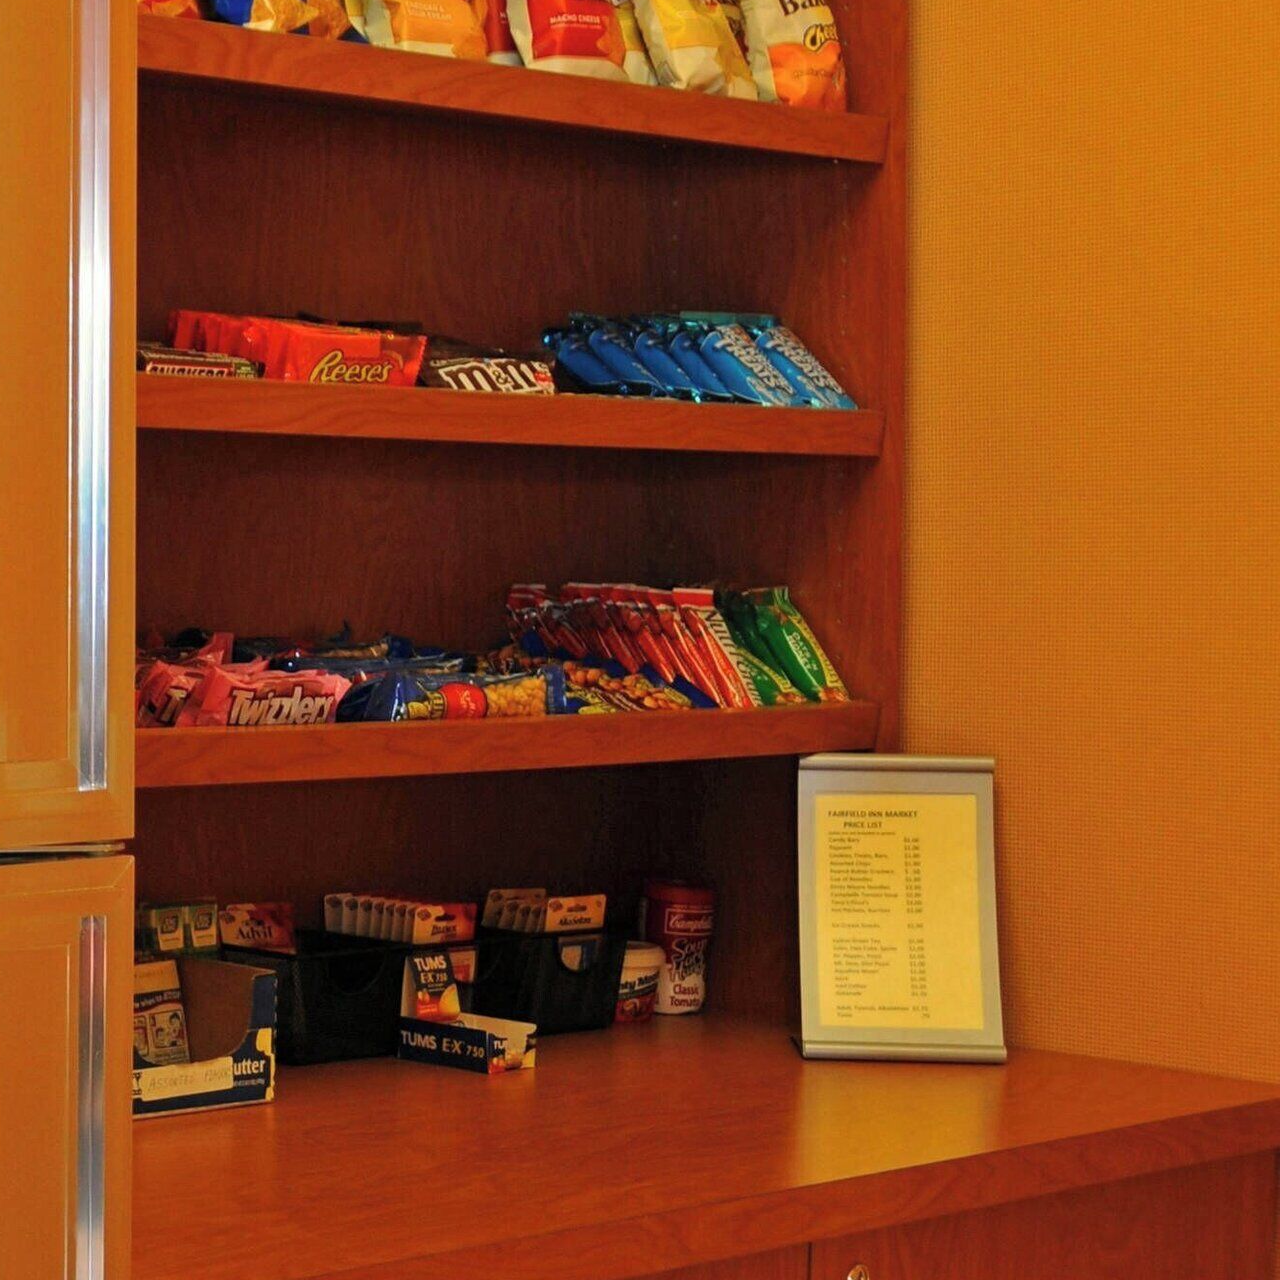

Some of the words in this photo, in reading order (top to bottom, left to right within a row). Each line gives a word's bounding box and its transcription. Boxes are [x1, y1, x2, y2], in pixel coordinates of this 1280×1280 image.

[308, 348, 395, 385] Reese's
[230, 686, 334, 726] Twizzlers
[828, 810, 867, 818] FAIRFIELD
[868, 810, 883, 818] INN
[885, 810, 918, 818] MARKET
[843, 821, 865, 829] PRICE
[867, 821, 882, 829] LIST
[236, 925, 273, 940] Advil
[414, 955, 447, 972] TUMS
[673, 983, 700, 996] Classic
[669, 995, 702, 1008] Tomato
[401, 1029, 438, 1051] TUMS
[466, 1044, 486, 1059] 750
